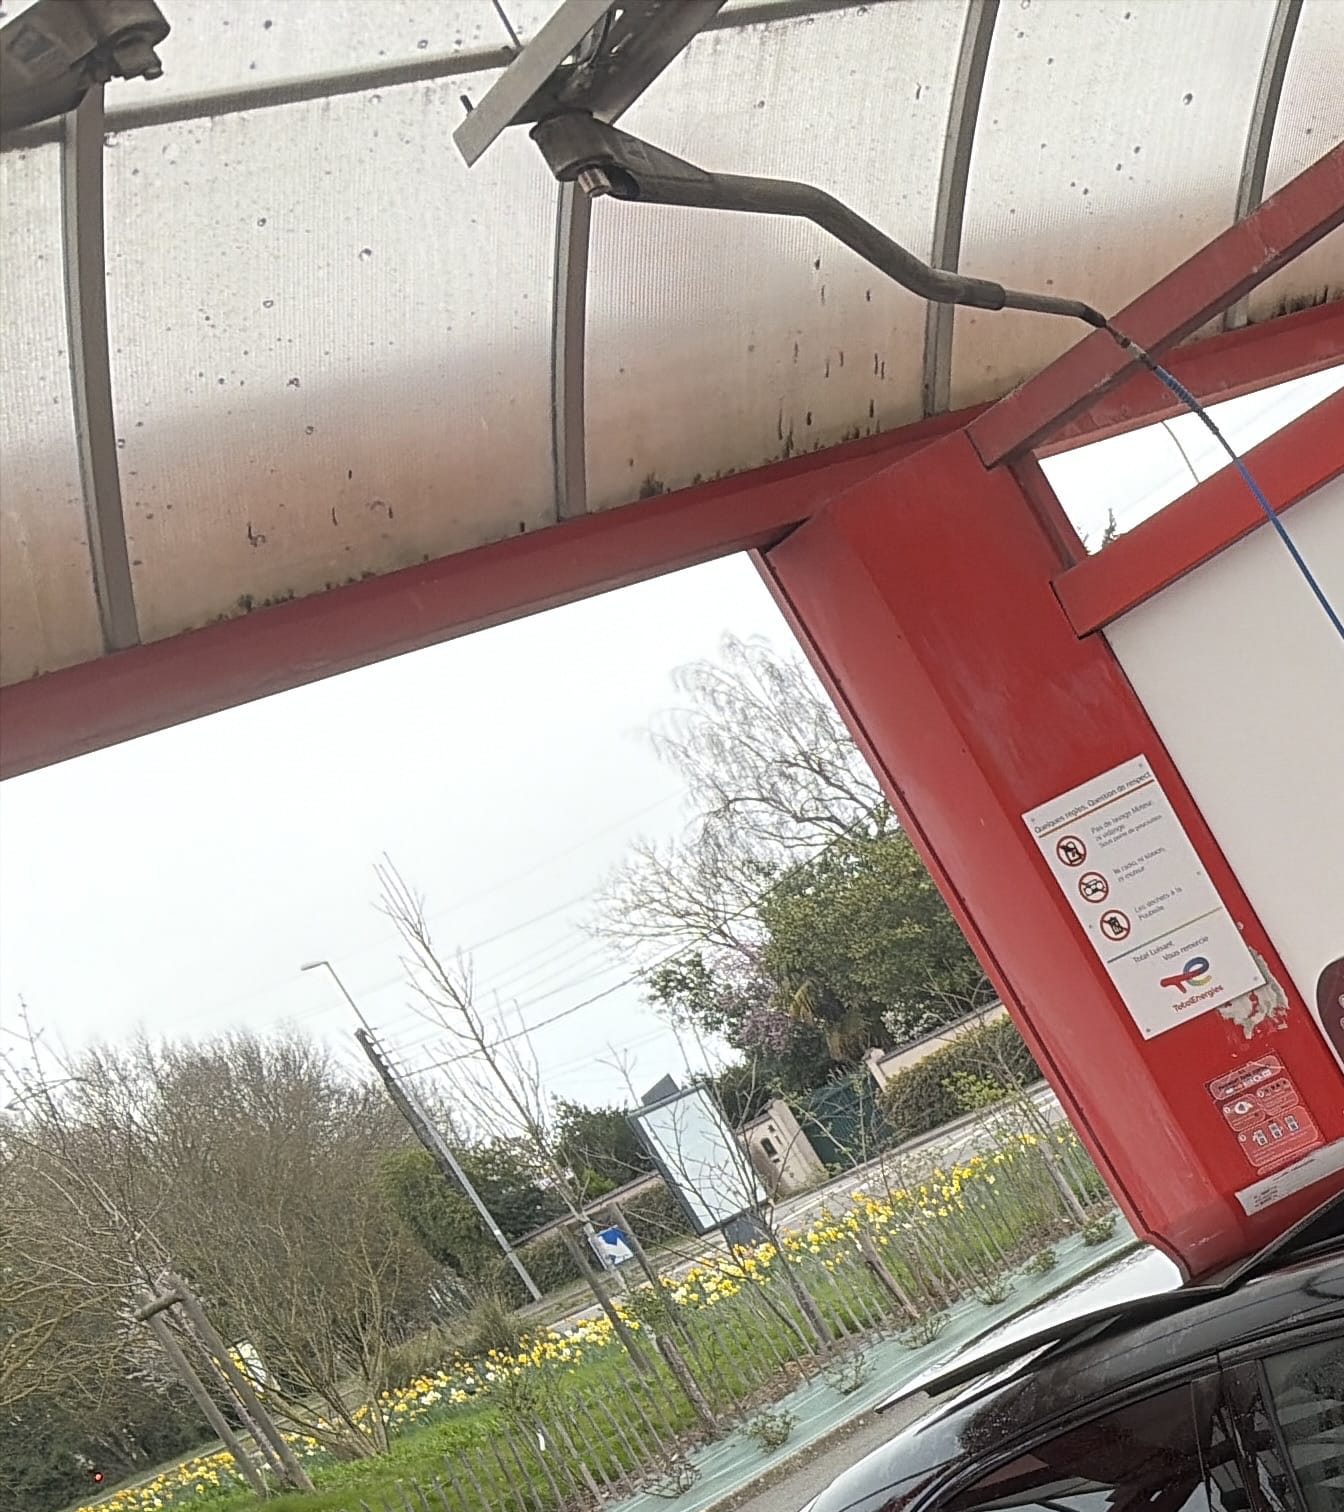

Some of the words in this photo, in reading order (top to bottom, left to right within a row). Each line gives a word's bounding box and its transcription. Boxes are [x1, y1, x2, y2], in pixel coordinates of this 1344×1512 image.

[1085, 786, 1117, 807] Question
[1124, 769, 1152, 789] respect
[1161, 948, 1180, 961] Vous
[1171, 982, 1225, 1014] TotalEnergies
